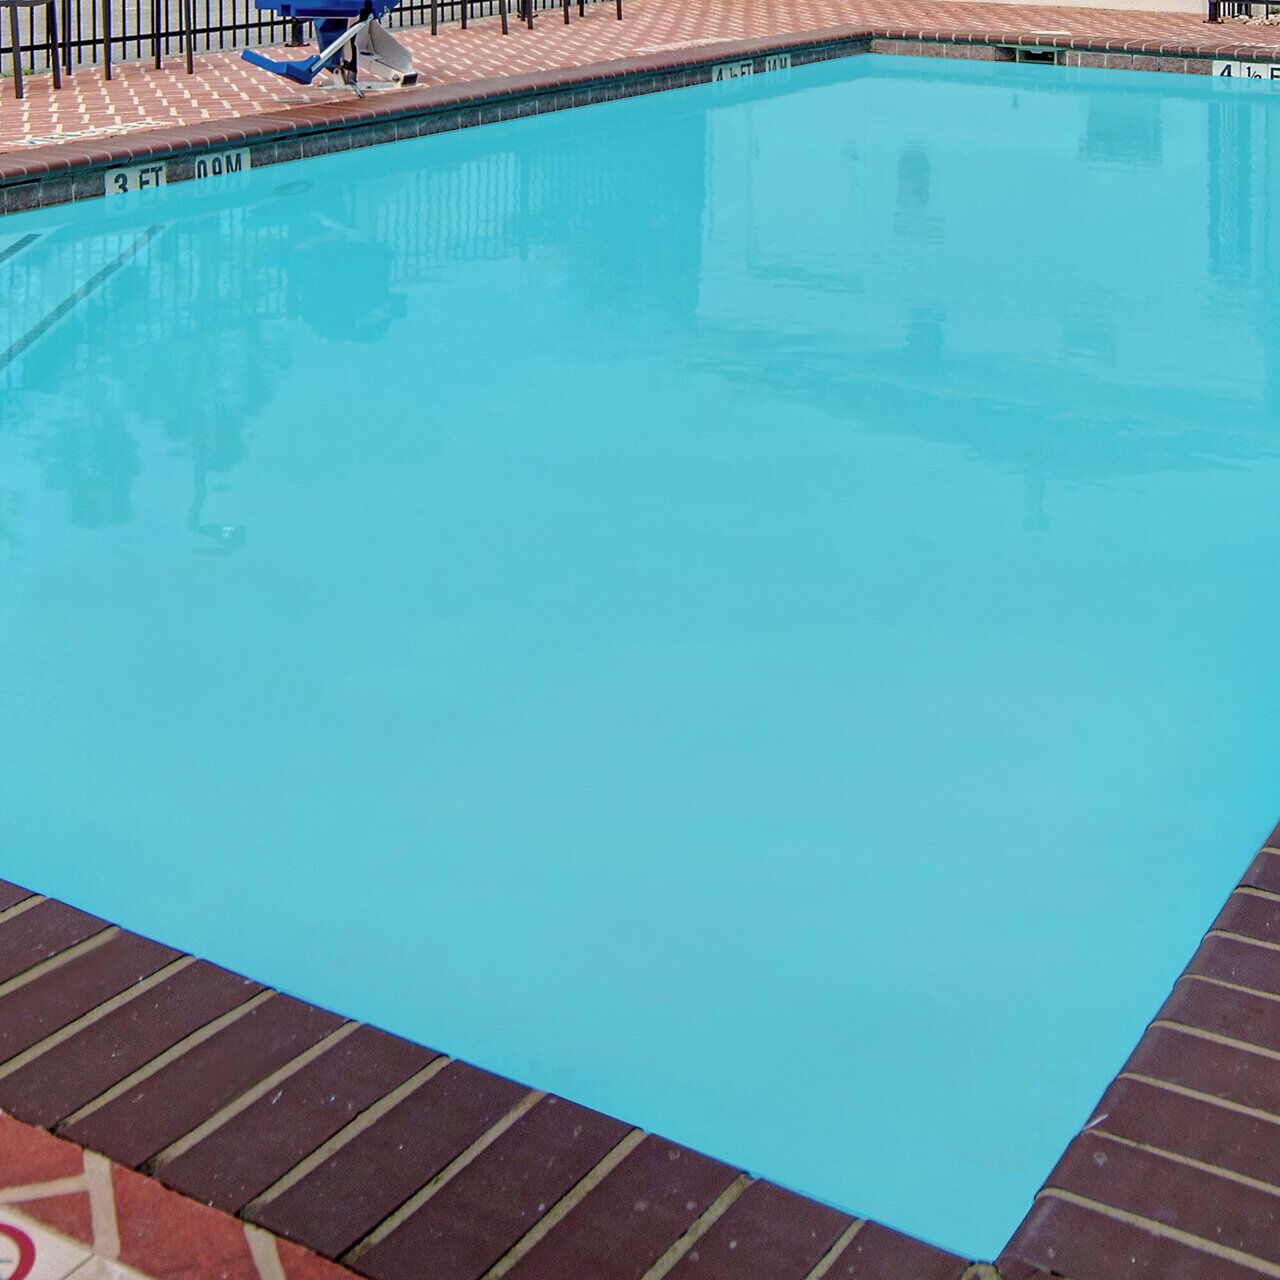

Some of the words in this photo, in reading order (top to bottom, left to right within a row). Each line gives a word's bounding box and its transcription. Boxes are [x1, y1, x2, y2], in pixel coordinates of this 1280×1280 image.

[1220, 63, 1233, 77] 4
[114, 172, 129, 193] 3
[139, 165, 163, 190] FT
